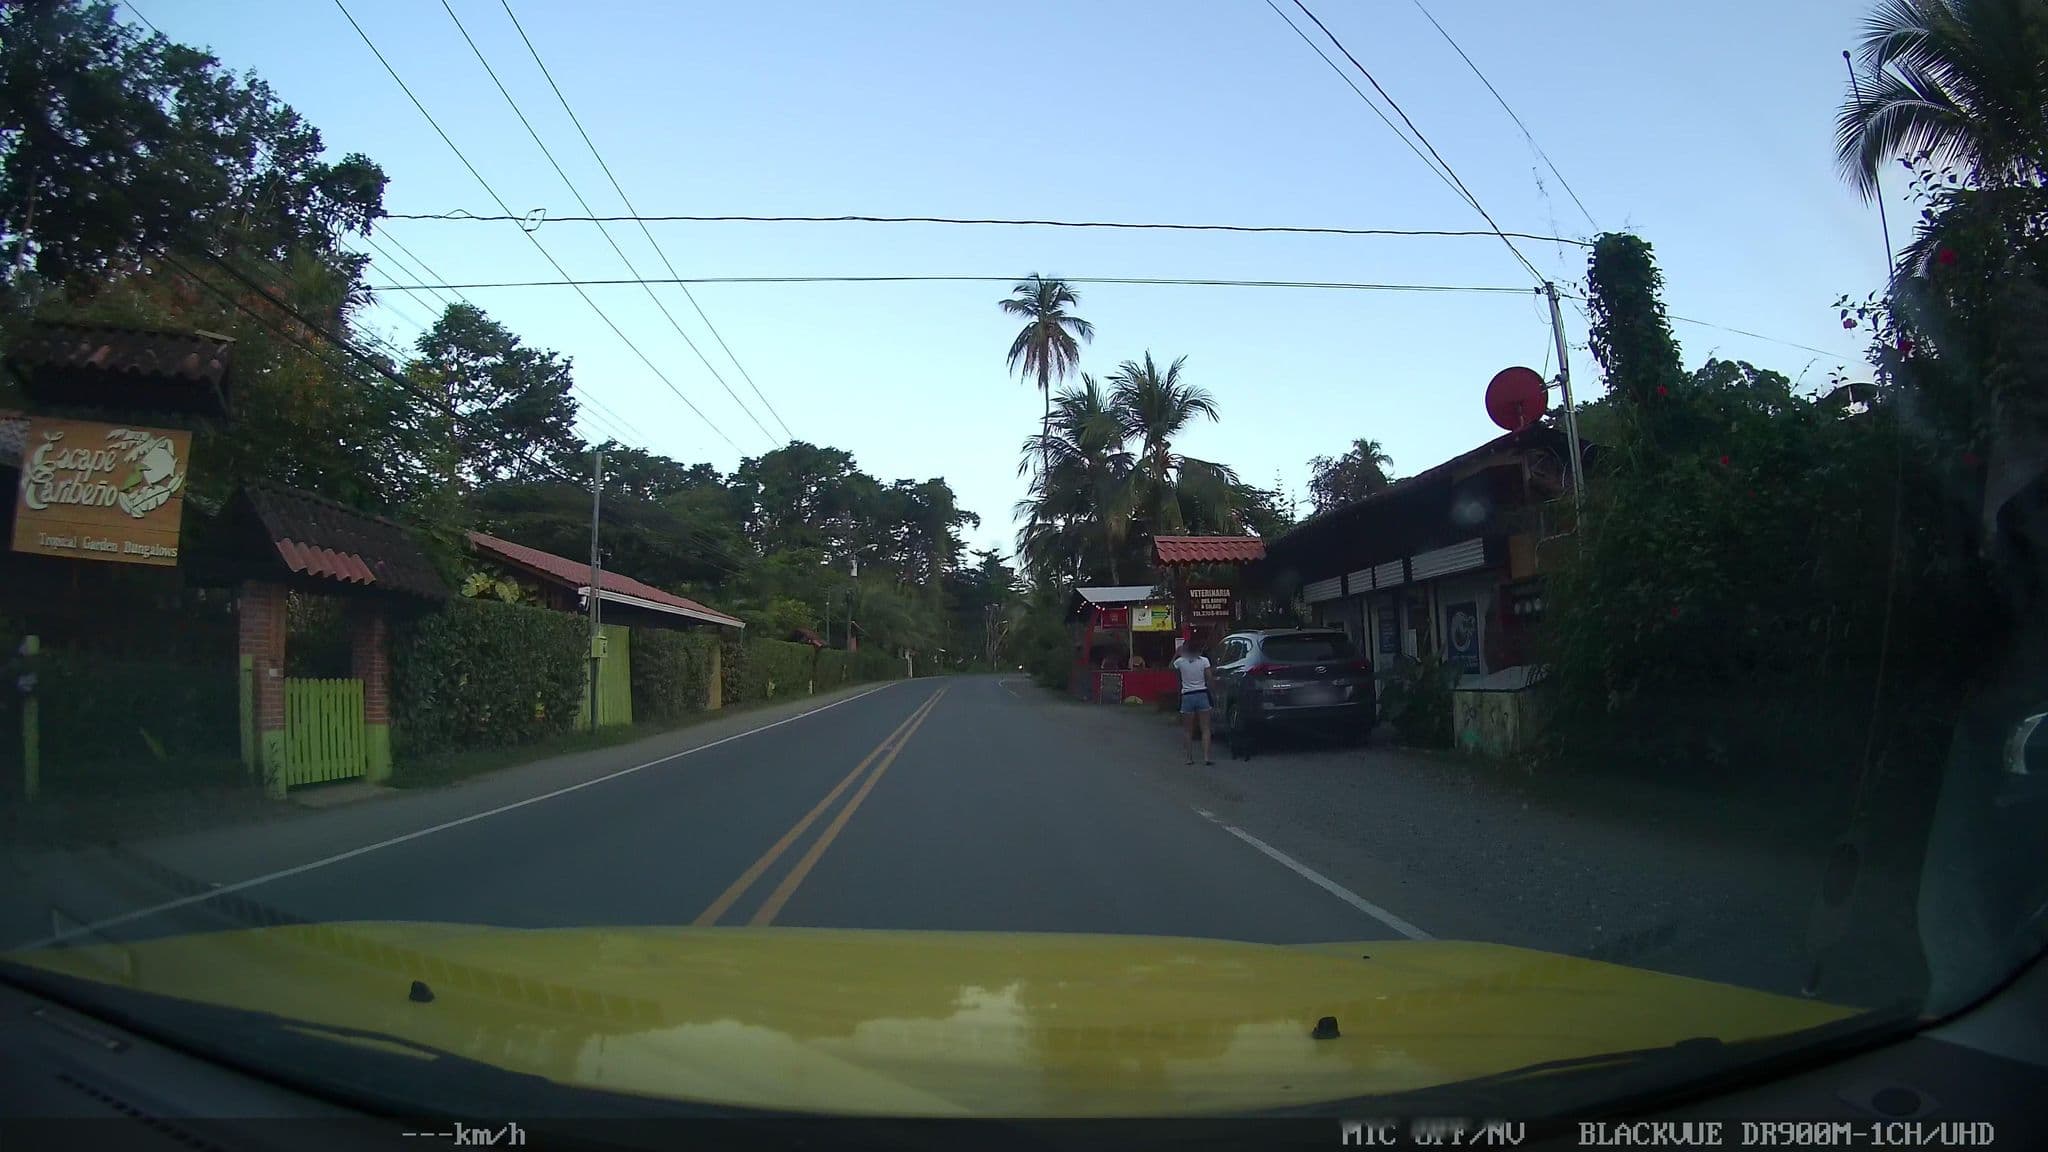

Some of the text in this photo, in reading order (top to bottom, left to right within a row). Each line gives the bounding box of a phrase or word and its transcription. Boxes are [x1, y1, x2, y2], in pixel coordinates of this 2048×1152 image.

[33, 432, 117, 481] Escape
[40, 532, 178, 558] Tropical Garden Bungalows
